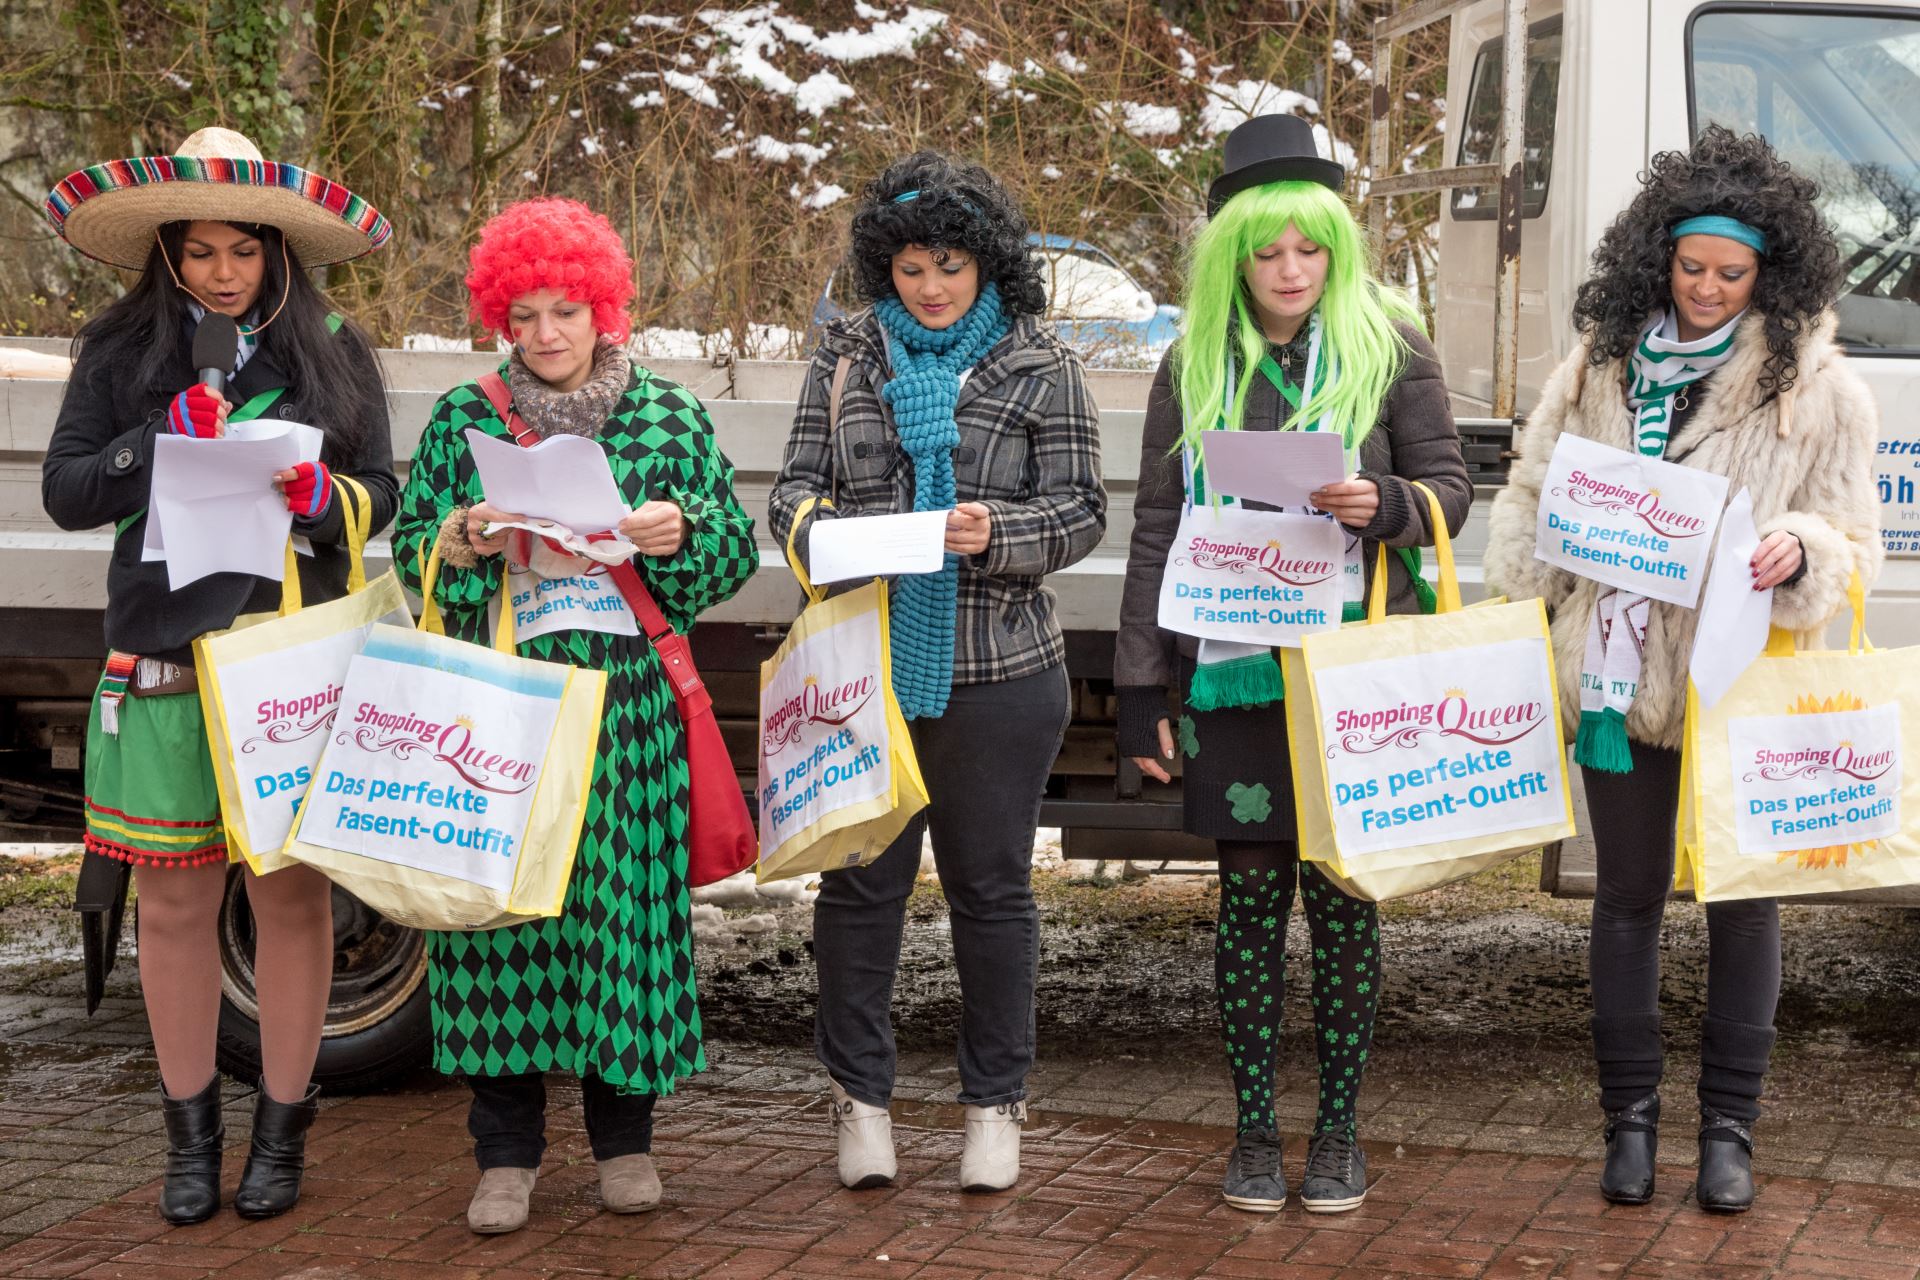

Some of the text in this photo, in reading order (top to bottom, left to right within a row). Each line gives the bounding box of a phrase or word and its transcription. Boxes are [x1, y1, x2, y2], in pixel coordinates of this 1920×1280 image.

[1568, 470, 1707, 539] Shopping Queen
[1877, 473, 1914, 504] öh
[1548, 512, 1669, 553] Das perfekte
[1188, 537, 1337, 587] Shopping Queen
[1562, 539, 1688, 581] Fasent-Outfit
[511, 590, 531, 608] as
[1175, 582, 1304, 603] Das perfekte
[1193, 606, 1327, 625] Fasent-Outfit
[257, 683, 343, 725] Shoppin
[803, 675, 877, 726] Queen
[1335, 696, 1547, 746] Shopping Queen
[353, 702, 536, 795] Shopping Queen
[763, 727, 855, 811] Das perfekte
[1754, 746, 1897, 781] Shopping Queen
[254, 765, 311, 799] Das
[326, 771, 489, 814] Das perfekte
[771, 744, 881, 831] Fasent-Outfit
[1335, 749, 1513, 806] Das perfekte
[1361, 771, 1548, 833] Fasent-Outfit
[1749, 783, 1876, 815] Das perfekte
[1771, 798, 1893, 836] Fasent-Outfit
[336, 806, 514, 858] Fasent-Outfit
